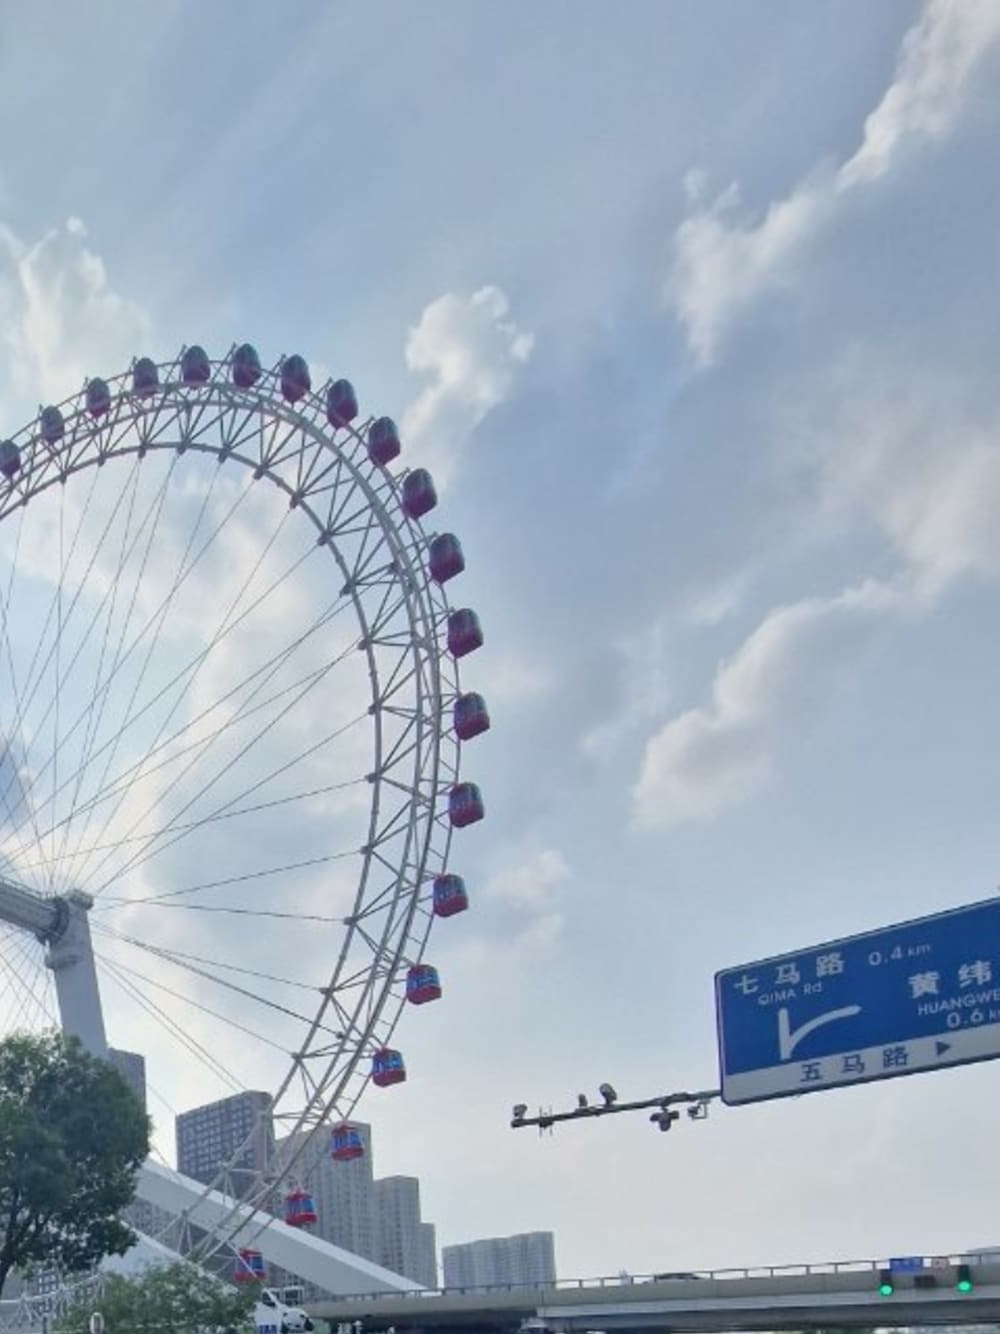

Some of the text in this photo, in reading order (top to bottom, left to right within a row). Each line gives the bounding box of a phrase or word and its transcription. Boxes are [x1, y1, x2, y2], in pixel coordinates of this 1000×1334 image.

[868, 944, 931, 966] 0.4 km
[733, 952, 845, 995] 七马路
[907, 959, 992, 999] 黄纬
[757, 981, 823, 1006] QIMA Rd
[946, 1008, 984, 1029] 0.6
[799, 1046, 908, 1083] 五马路
